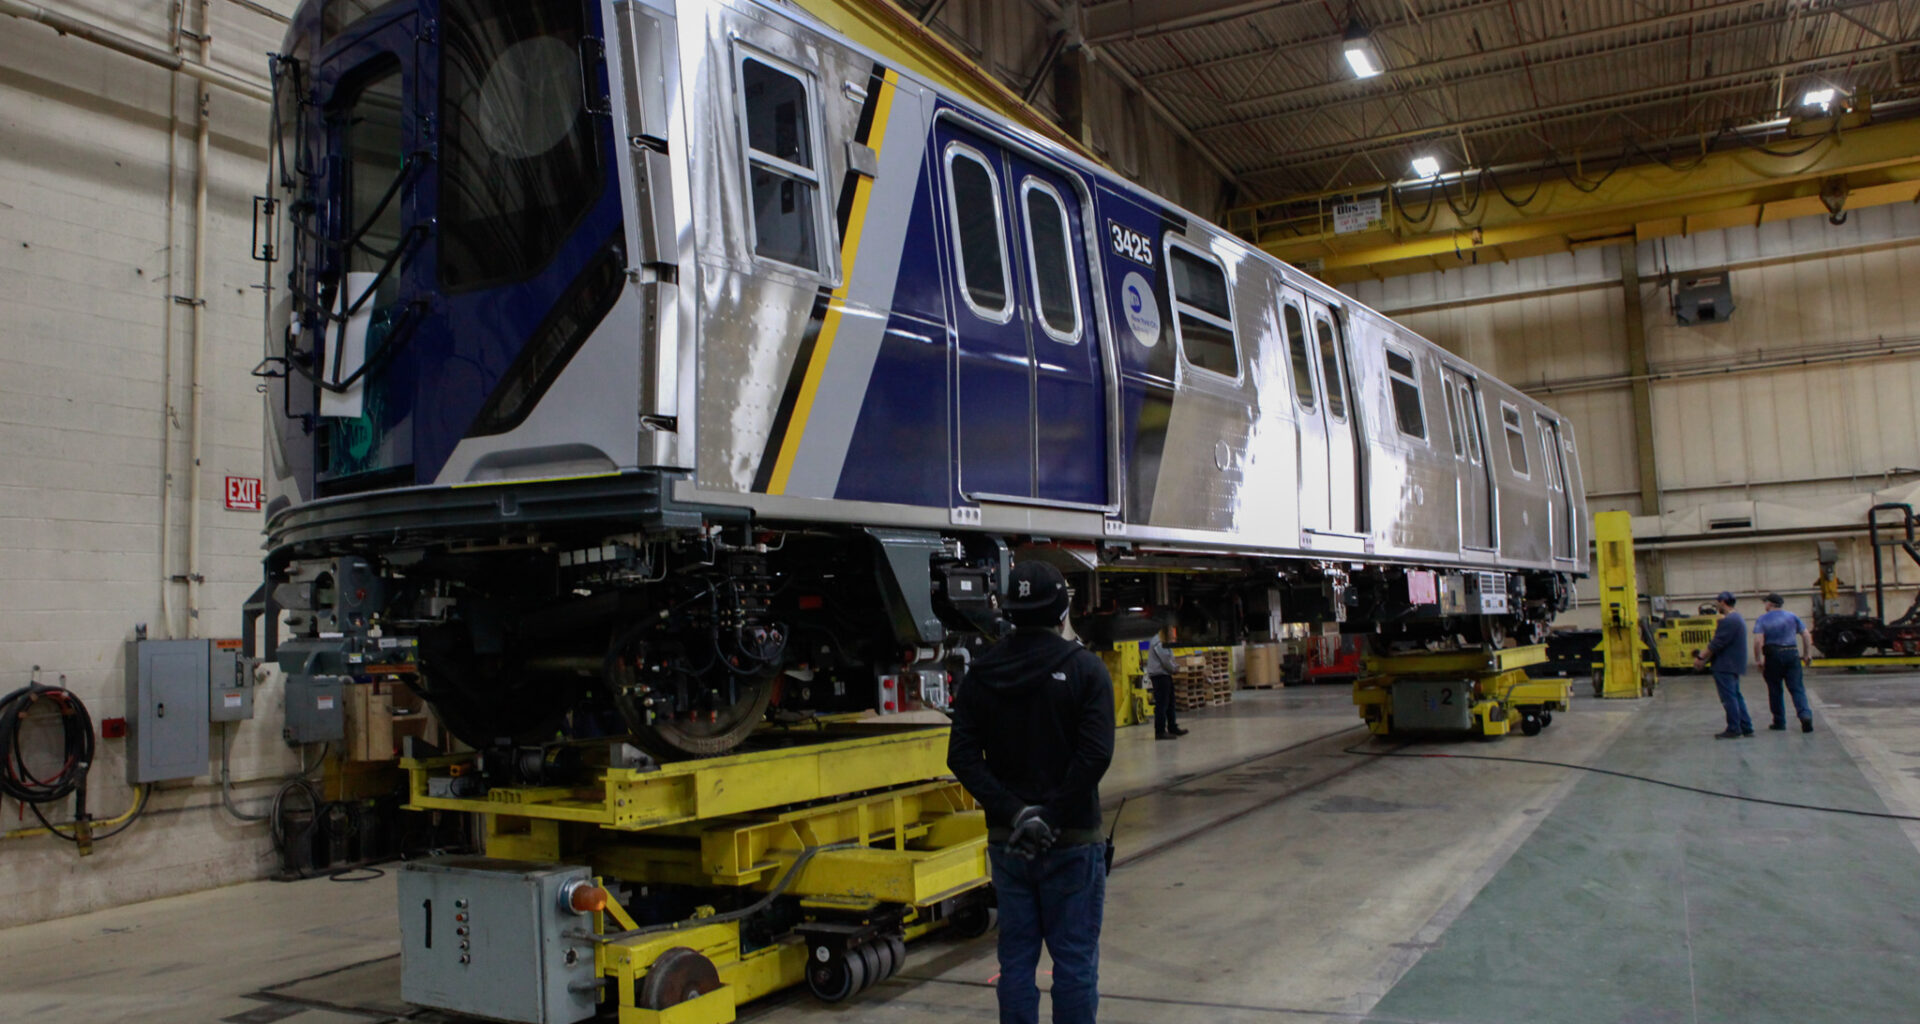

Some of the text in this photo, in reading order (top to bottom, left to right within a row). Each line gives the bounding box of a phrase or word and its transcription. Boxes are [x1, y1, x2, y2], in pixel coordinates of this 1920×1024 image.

[1112, 224, 1153, 265] 3425
[229, 478, 258, 501] EXIT
[1441, 687, 1453, 705] 2
[422, 899, 432, 949] 1
